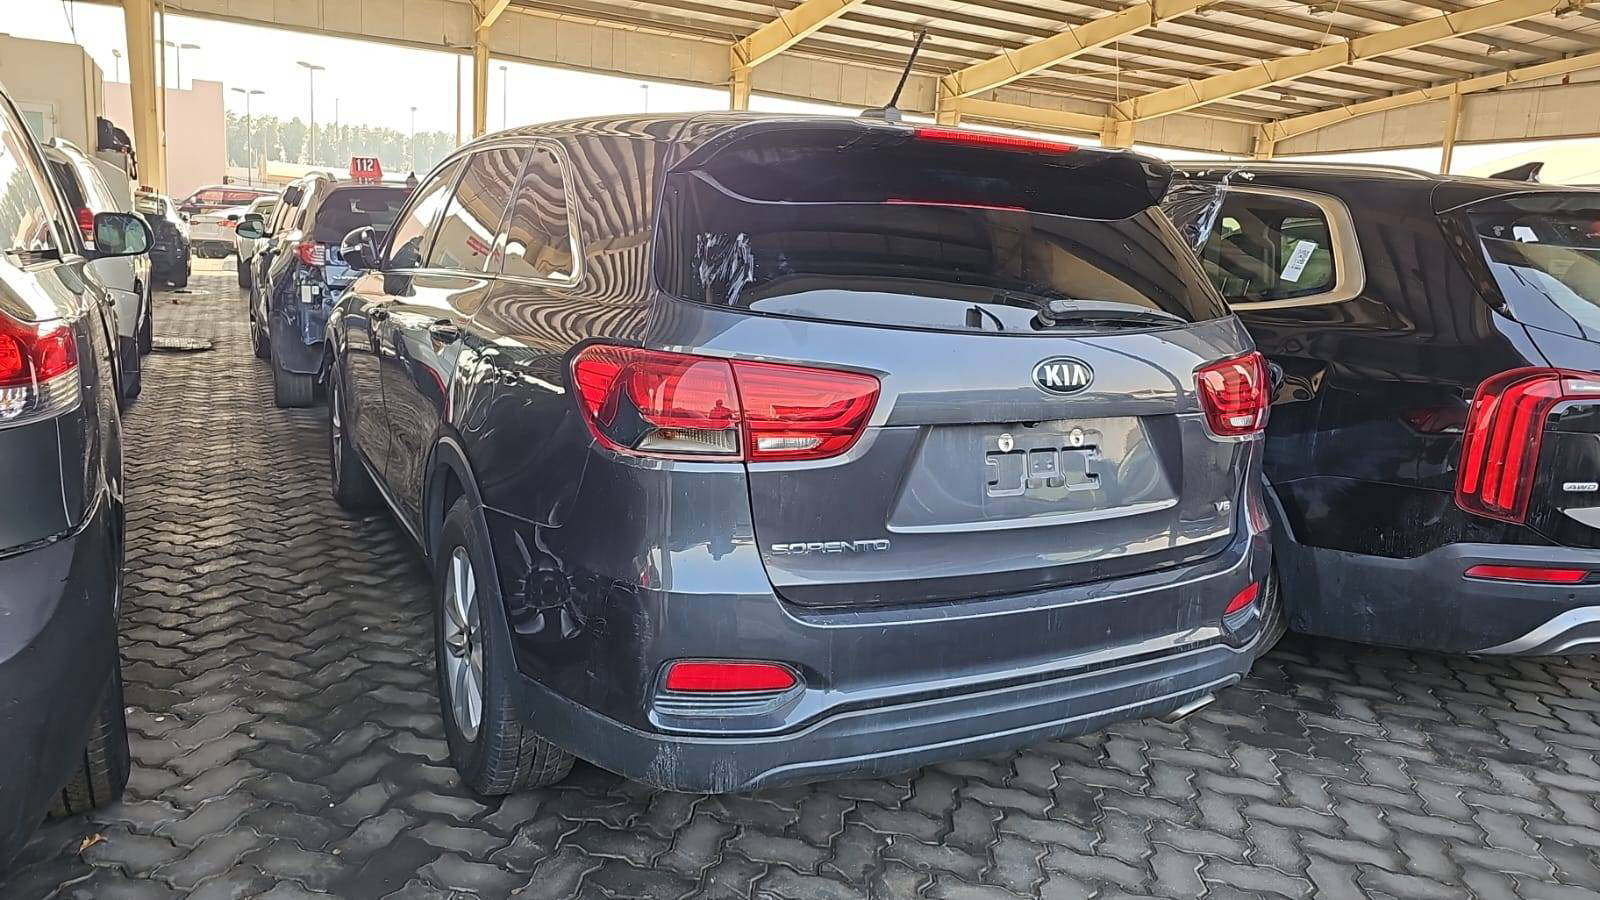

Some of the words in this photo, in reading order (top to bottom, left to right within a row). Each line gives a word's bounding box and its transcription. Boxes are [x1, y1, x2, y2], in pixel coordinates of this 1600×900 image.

[355, 158, 374, 172] 112
[1043, 364, 1087, 387] KIA
[1214, 500, 1231, 512] V6
[771, 539, 890, 555] SORENTO
